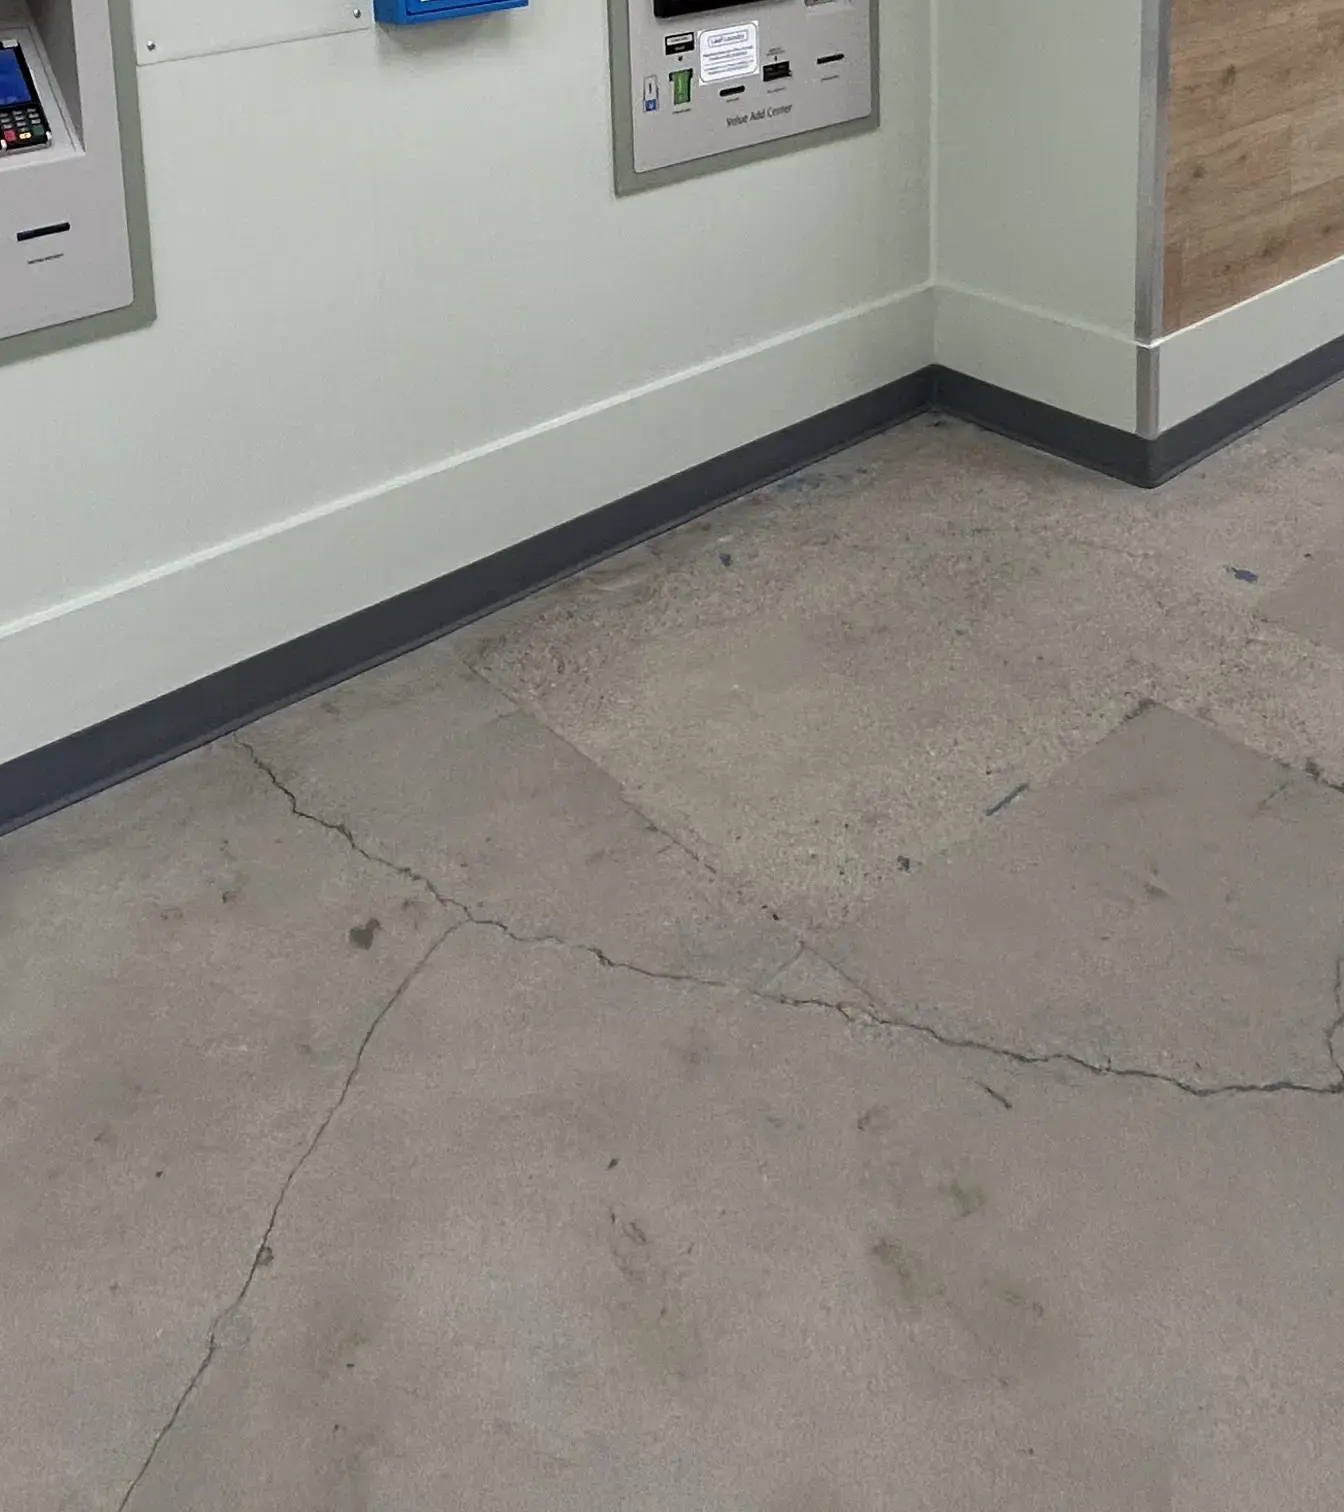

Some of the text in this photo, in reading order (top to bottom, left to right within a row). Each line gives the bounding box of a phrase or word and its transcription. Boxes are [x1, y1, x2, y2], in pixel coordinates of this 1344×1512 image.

[726, 103, 793, 128] Value Add Center
